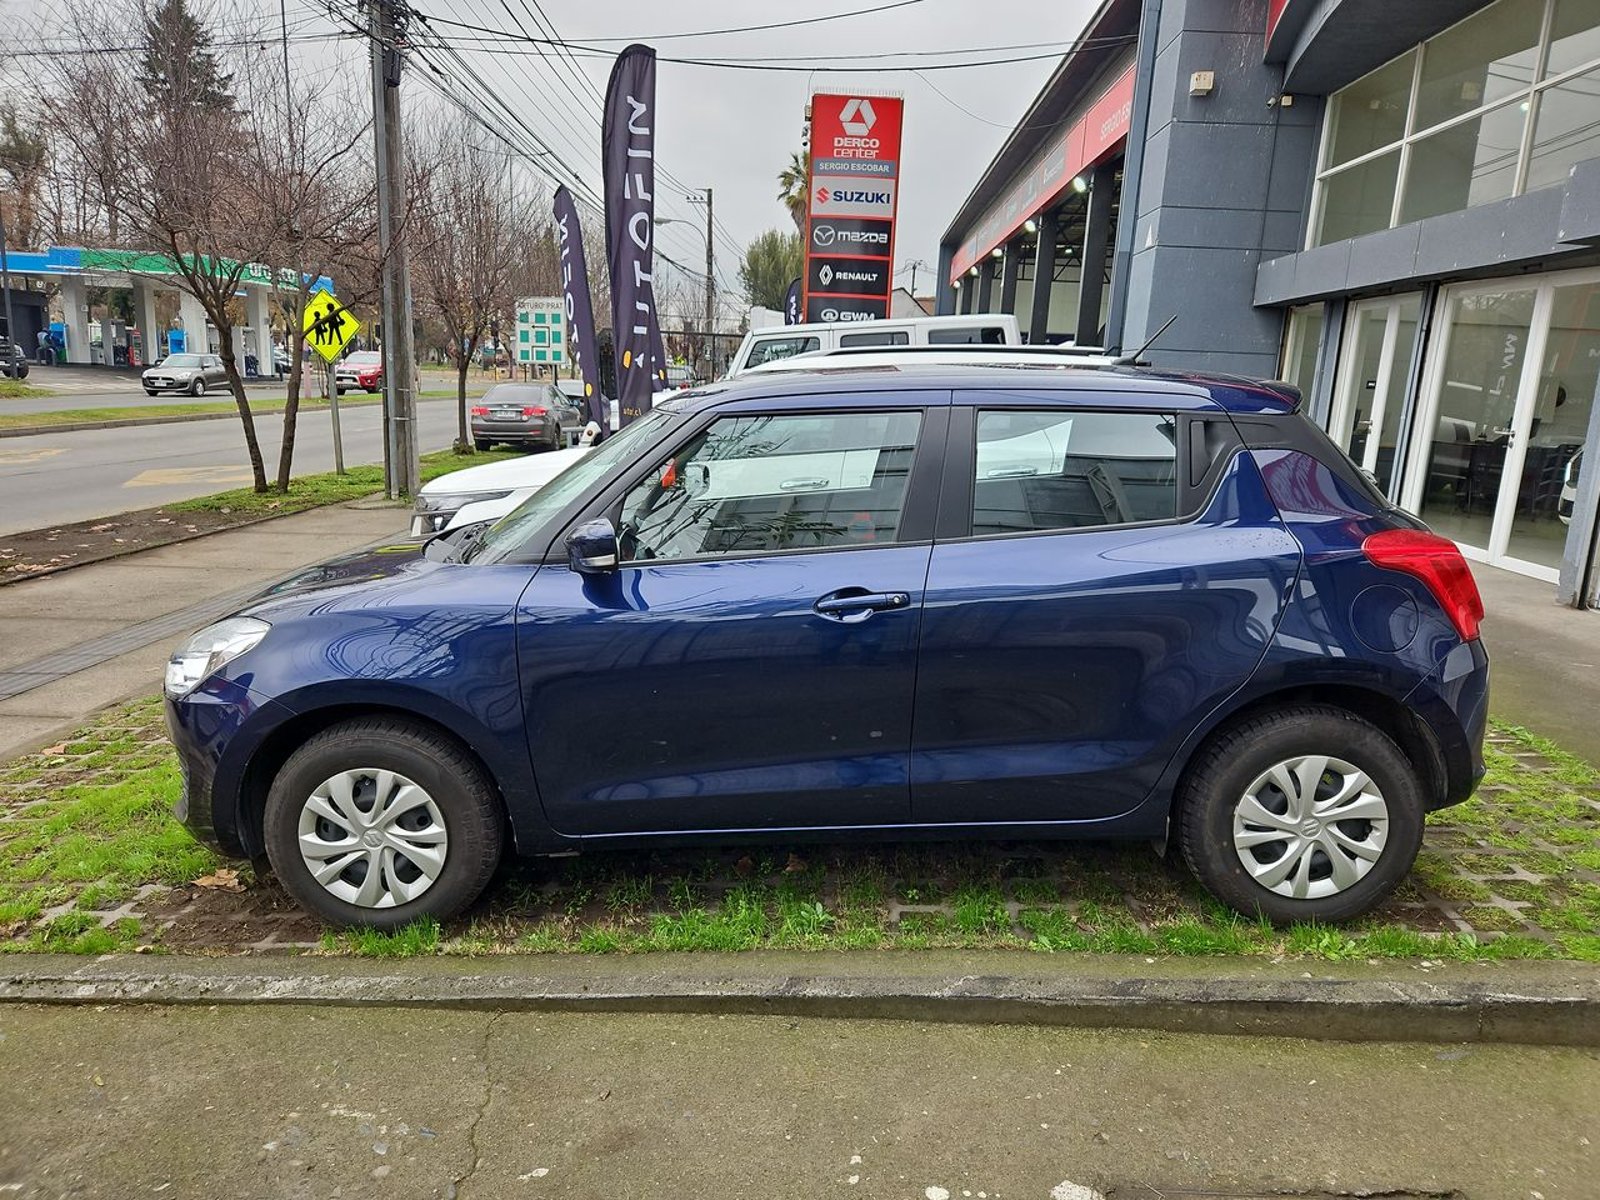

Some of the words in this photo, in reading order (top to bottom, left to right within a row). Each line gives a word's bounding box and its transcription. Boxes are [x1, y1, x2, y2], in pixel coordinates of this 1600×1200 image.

[833, 137, 880, 149] DERCO
[833, 148, 879, 159] center
[819, 162, 850, 172] SERGIO
[850, 163, 890, 173] ESCOBAR
[833, 190, 891, 205] SUZUKI
[837, 230, 888, 244] mazda
[835, 272, 878, 282] RENAULT
[840, 311, 876, 321] GWM
